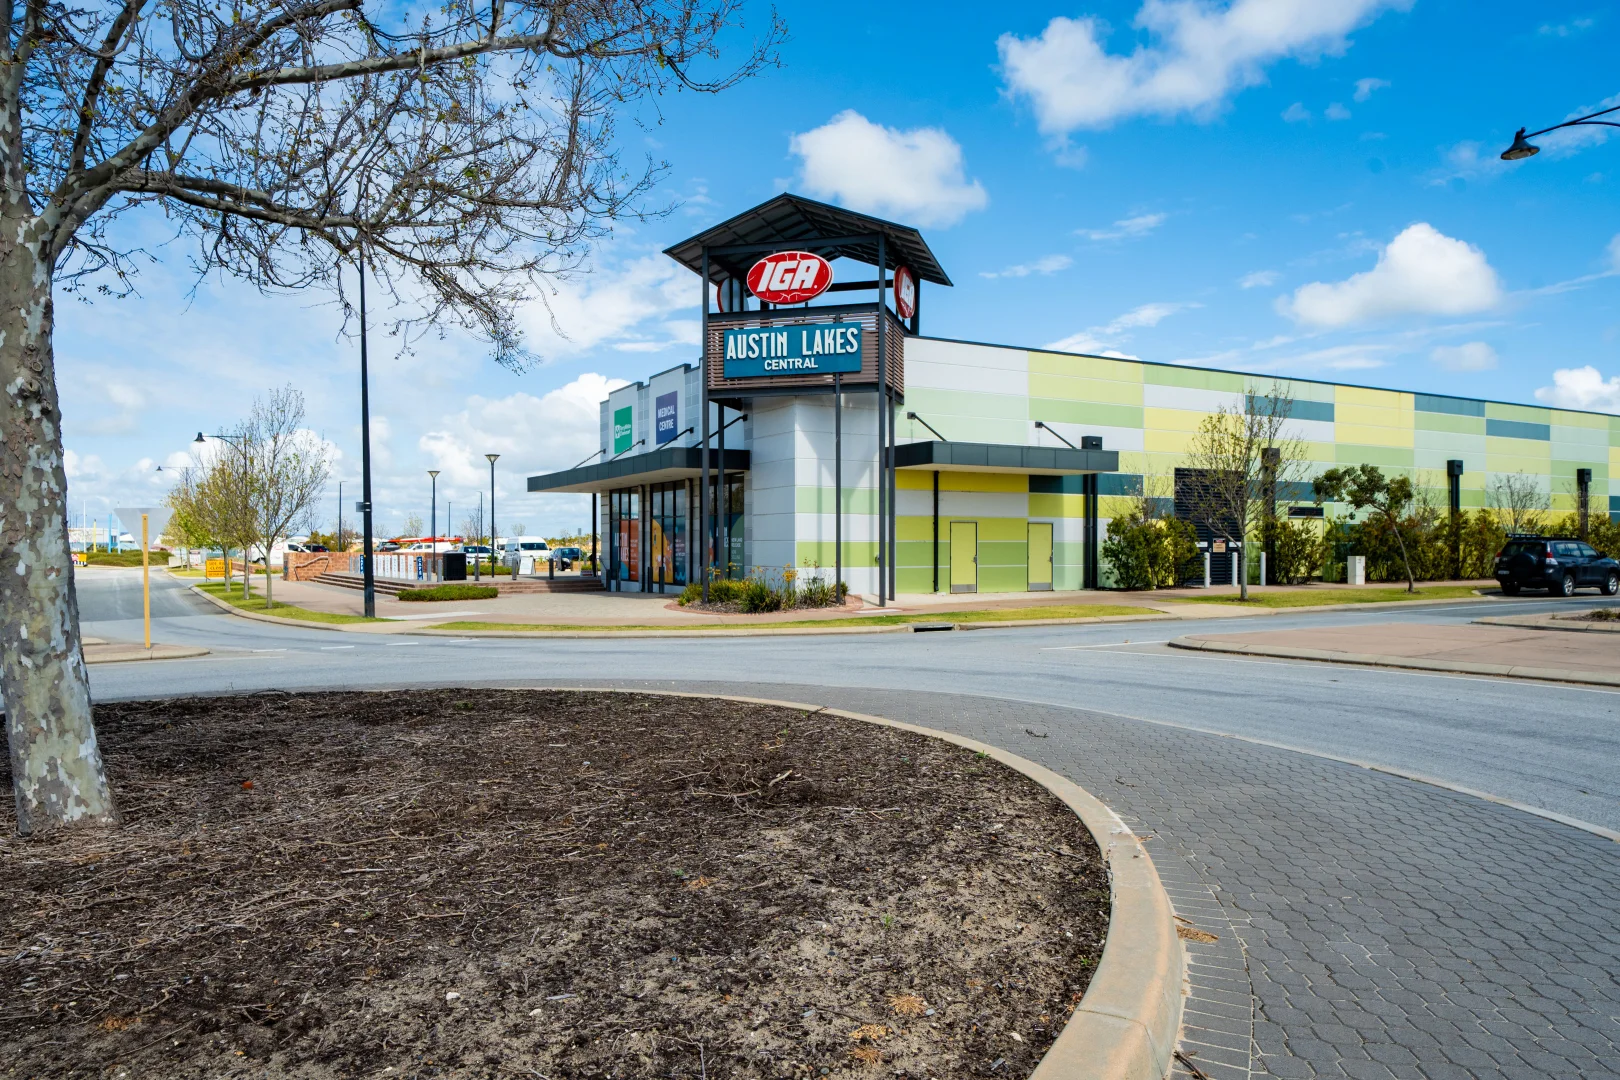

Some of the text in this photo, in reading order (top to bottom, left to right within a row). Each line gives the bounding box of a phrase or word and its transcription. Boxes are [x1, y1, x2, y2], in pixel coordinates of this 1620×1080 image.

[757, 258, 821, 293] IGA
[726, 327, 859, 360] AUSTIN LAKES
[764, 357, 819, 371] CENTRAL
[657, 404, 676, 419] MEDICAL
[658, 418, 674, 432] CENTRE
